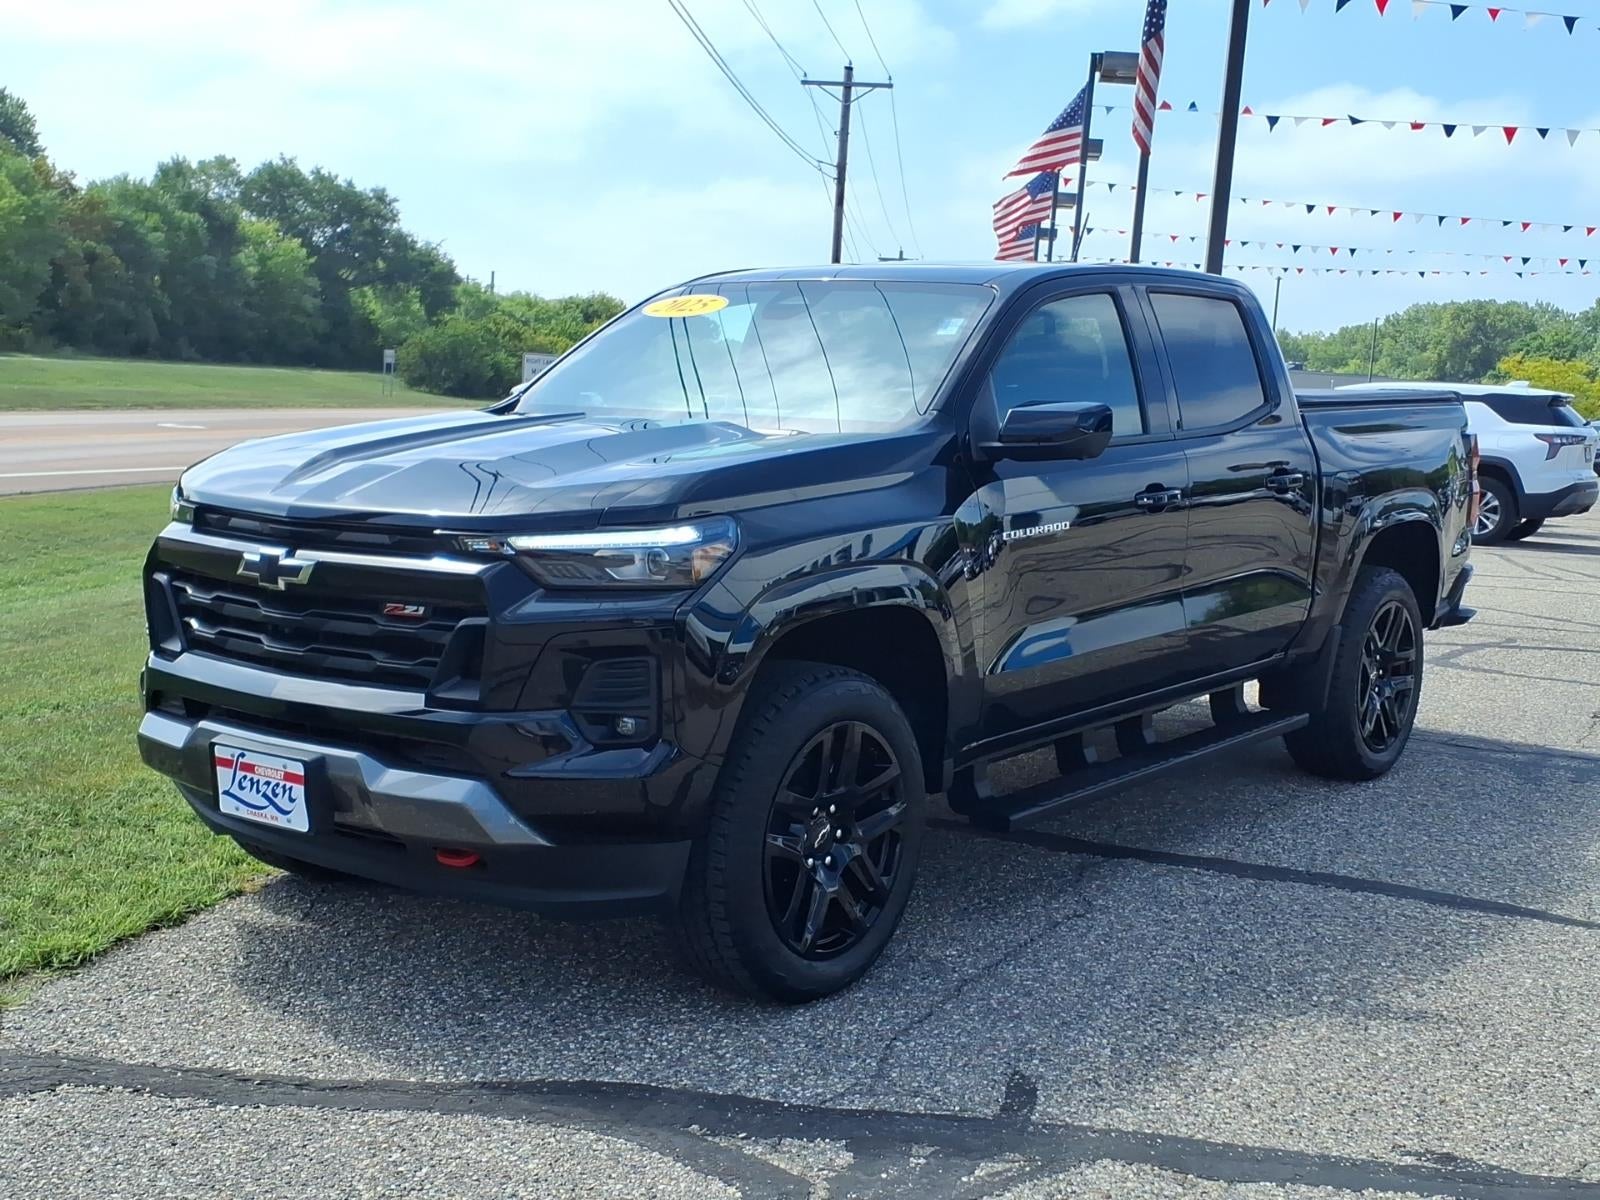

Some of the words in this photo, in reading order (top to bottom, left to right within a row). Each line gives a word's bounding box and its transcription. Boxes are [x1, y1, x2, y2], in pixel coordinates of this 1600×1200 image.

[1002, 521, 1070, 540] COLORADO
[384, 603, 425, 616] Z71
[254, 765, 284, 780] CHEVROLET
[221, 752, 298, 816] Lenzen
